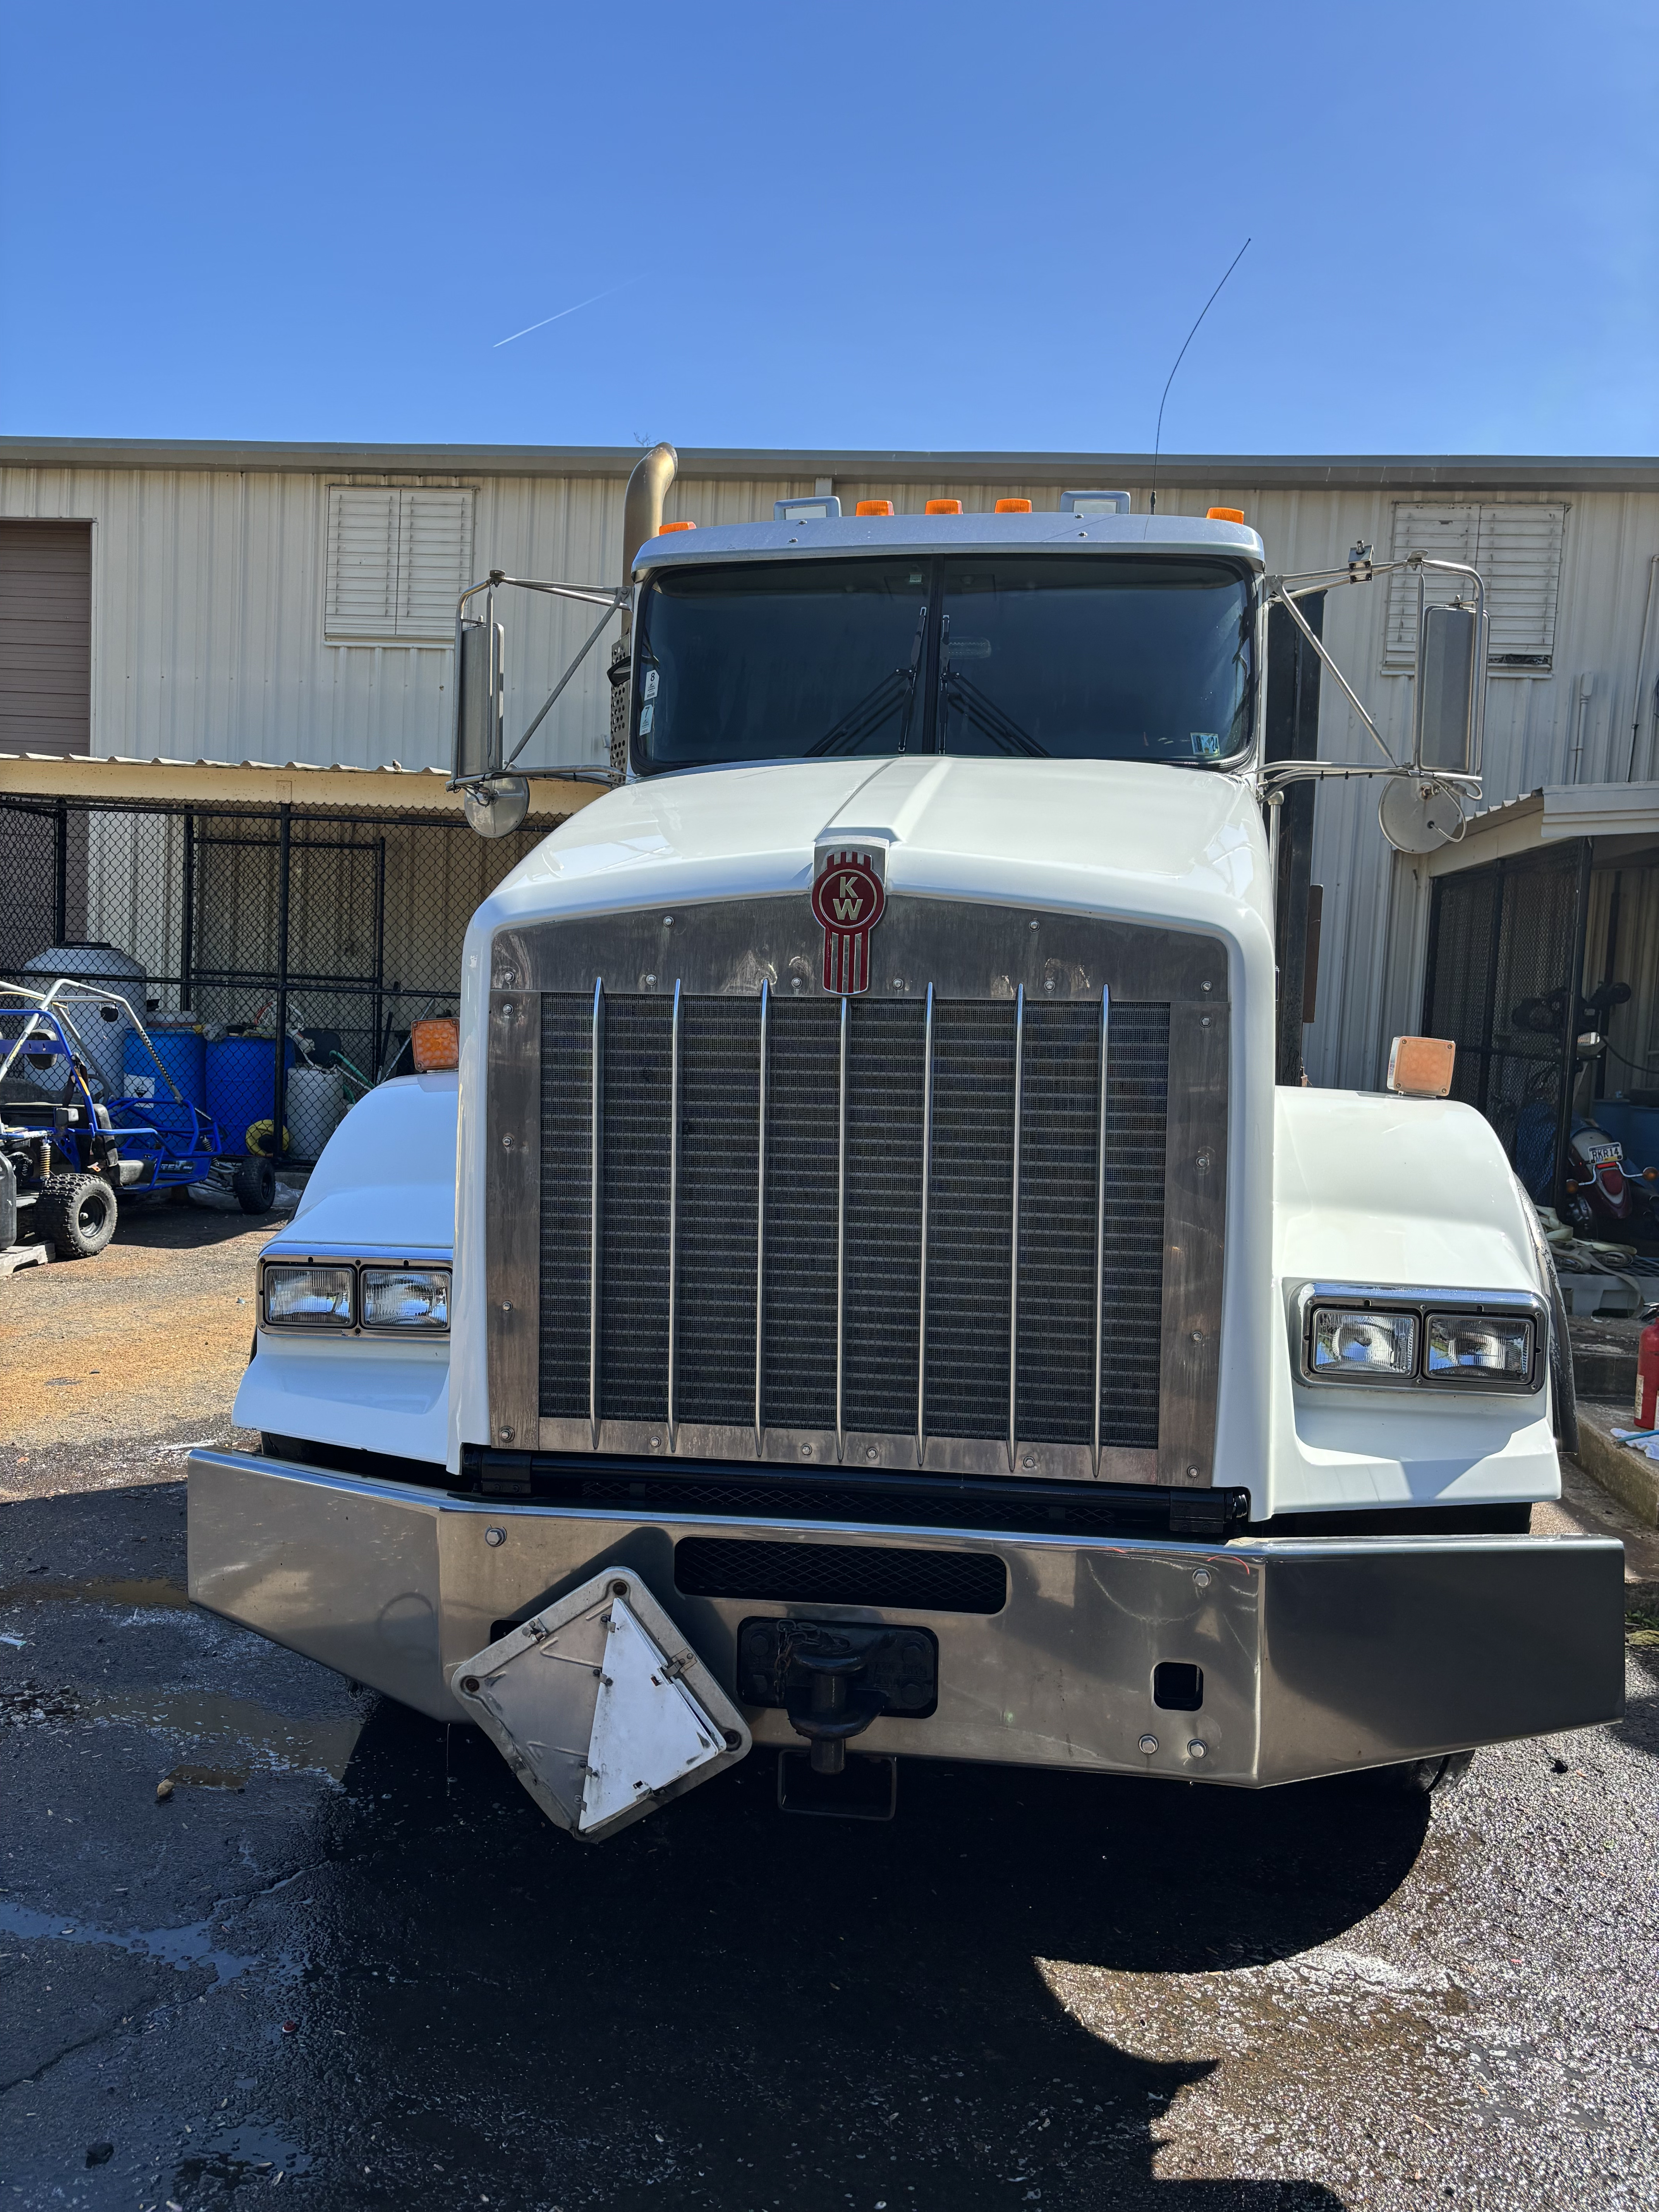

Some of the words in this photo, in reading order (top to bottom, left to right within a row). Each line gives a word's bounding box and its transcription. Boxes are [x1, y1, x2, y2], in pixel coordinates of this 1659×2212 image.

[651, 672, 655, 682] 8
[645, 706, 650, 718] 7
[1211, 737, 1219, 752] 24
[840, 876, 858, 898] K
[833, 898, 863, 920] W
[1592, 1147, 1619, 1161] RKR14
